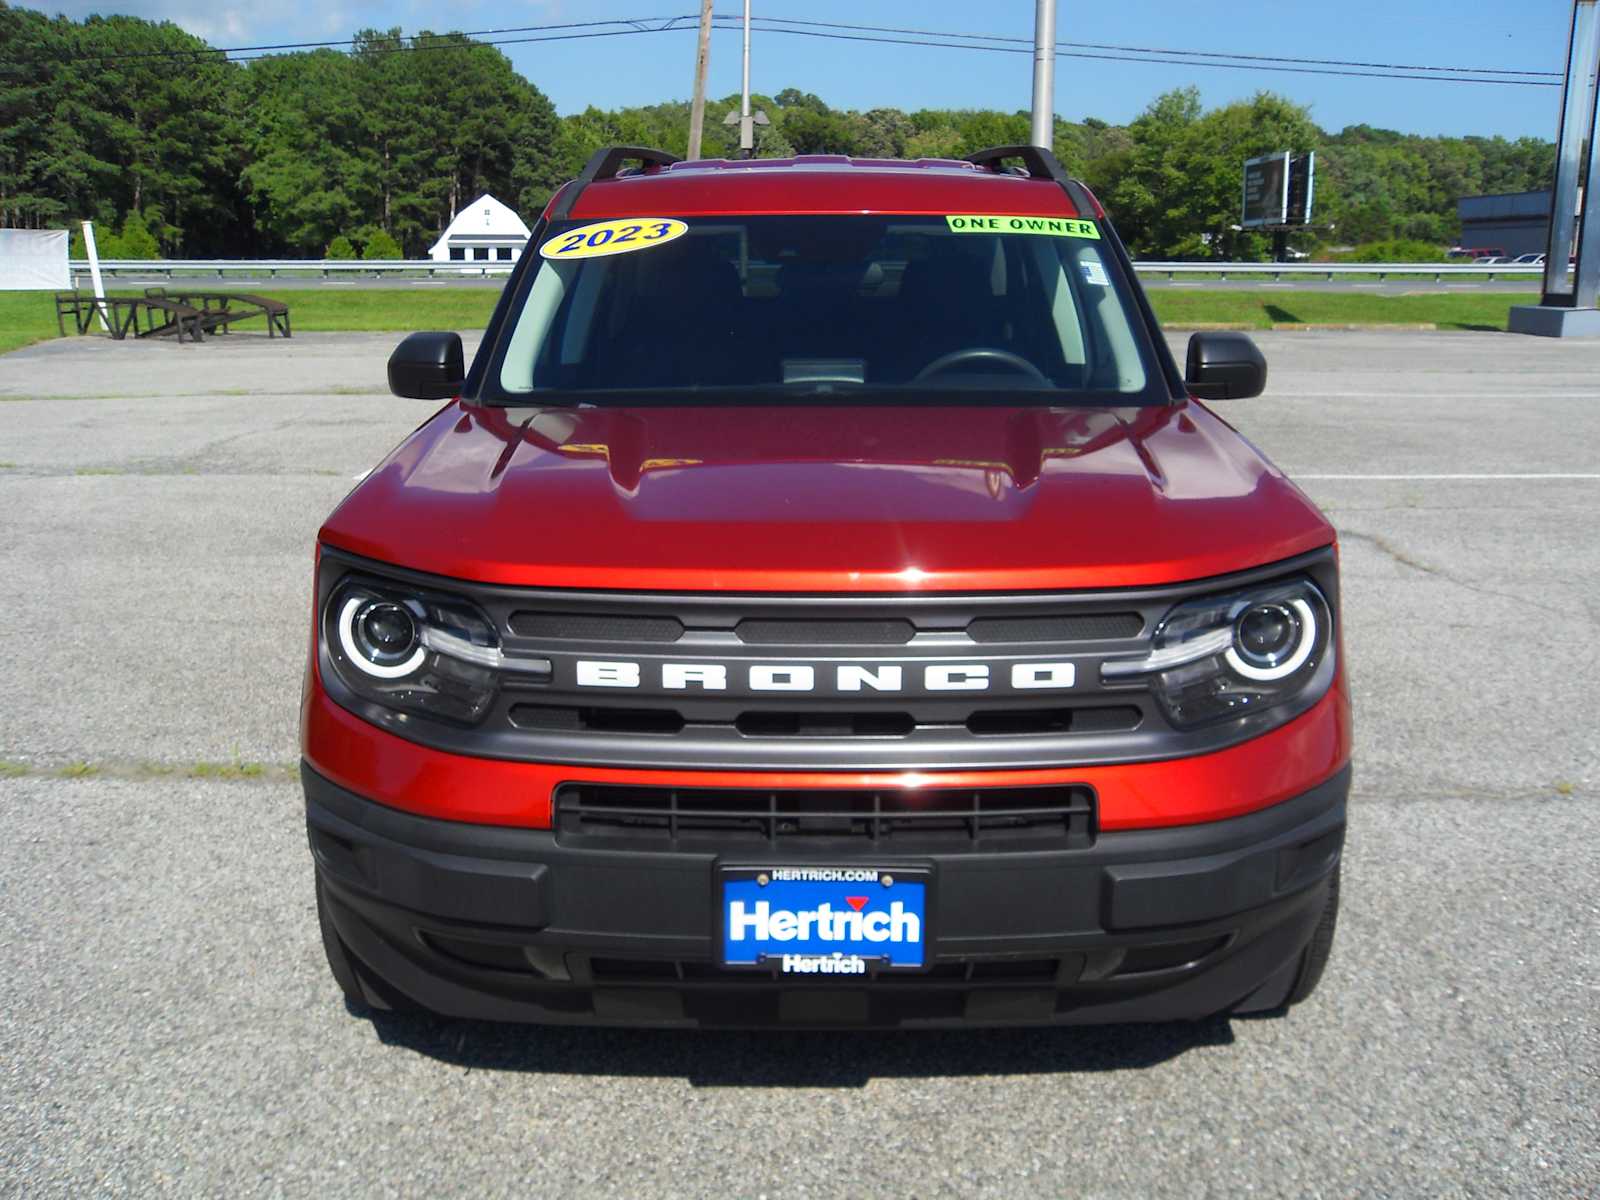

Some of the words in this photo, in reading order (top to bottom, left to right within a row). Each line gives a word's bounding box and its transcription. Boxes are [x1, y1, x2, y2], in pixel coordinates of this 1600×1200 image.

[556, 222, 672, 254] 2023
[952, 217, 1000, 229] ONE
[1009, 218, 1093, 235] OWNER
[576, 660, 1076, 692] BRONCO
[772, 869, 879, 882] HERTRICH.COM
[729, 901, 921, 943] Hertrich
[782, 952, 865, 973] Hertrich
